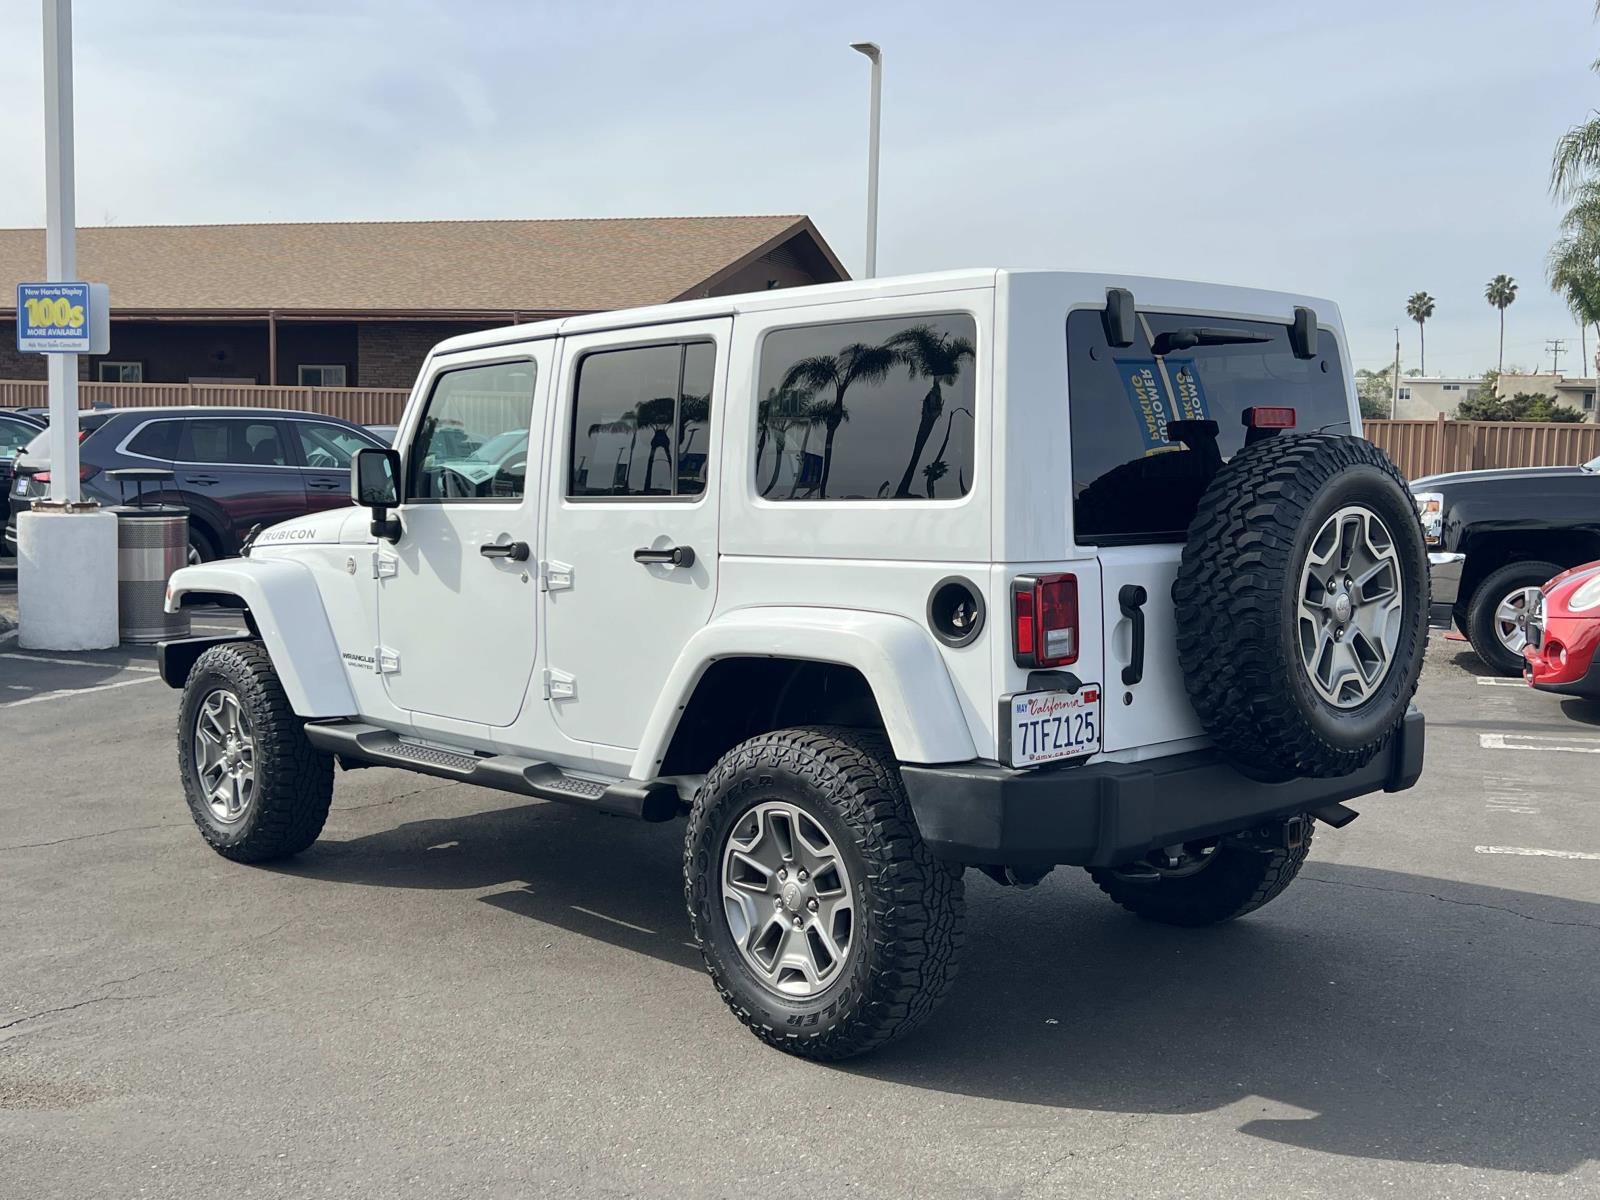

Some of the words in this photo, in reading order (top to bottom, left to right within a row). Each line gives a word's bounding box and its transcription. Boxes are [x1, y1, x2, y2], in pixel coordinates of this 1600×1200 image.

[25, 288, 39, 296] New
[61, 288, 82, 296] Display
[24, 297, 84, 328] 100s
[263, 529, 317, 541] RUBICON
[1016, 704, 1028, 714] MAY
[1030, 697, 1085, 717] California
[1018, 711, 1095, 756] 7TFZ125
[1035, 749, 1081, 761] dmv.ca.gov
